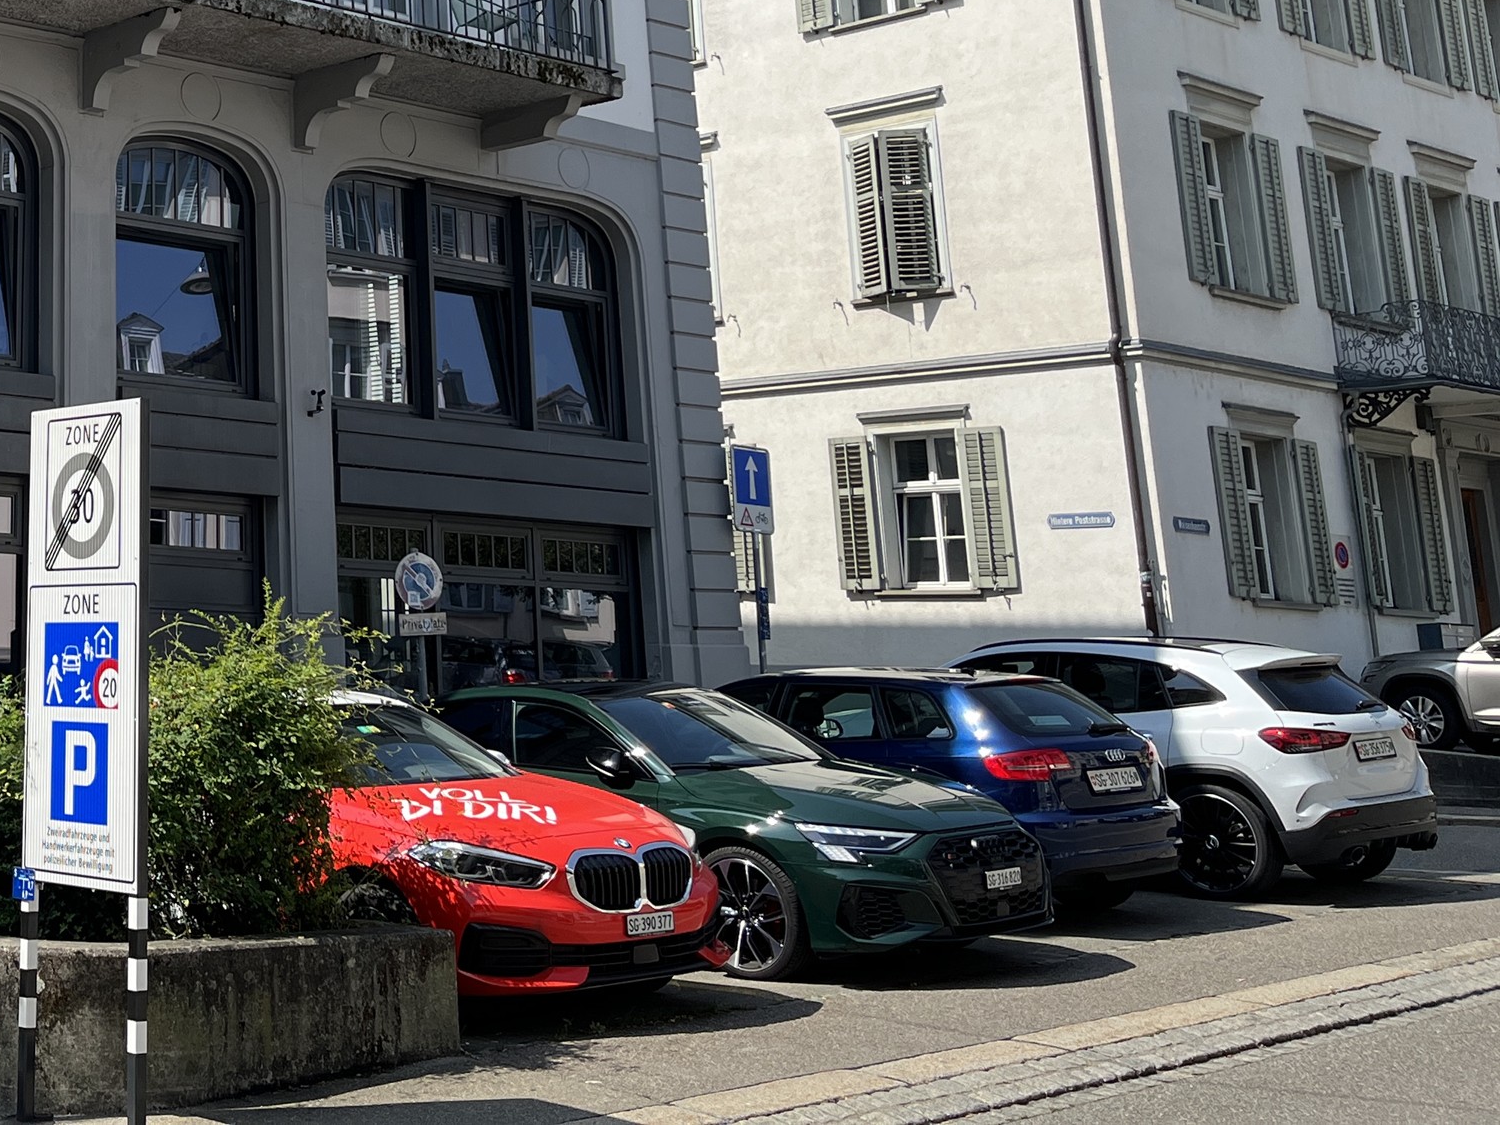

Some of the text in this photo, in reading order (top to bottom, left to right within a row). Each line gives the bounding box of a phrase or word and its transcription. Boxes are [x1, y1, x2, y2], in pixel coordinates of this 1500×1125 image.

[66, 424, 100, 445] ZONE
[70, 488, 94, 524] 30
[63, 594, 100, 615] ZONE
[102, 677, 117, 698] 20
[64, 729, 97, 816] P
[419, 787, 527, 803] VOLL
[391, 799, 557, 824] DI DIR!
[47, 826, 110, 843] Zweiradfahrzeuge und
[42, 839, 115, 858] Handwerkerfahrzeuge mit
[43, 855, 113, 875] polizeilicher Bewilligung
[658, 914, 671, 929] 377
